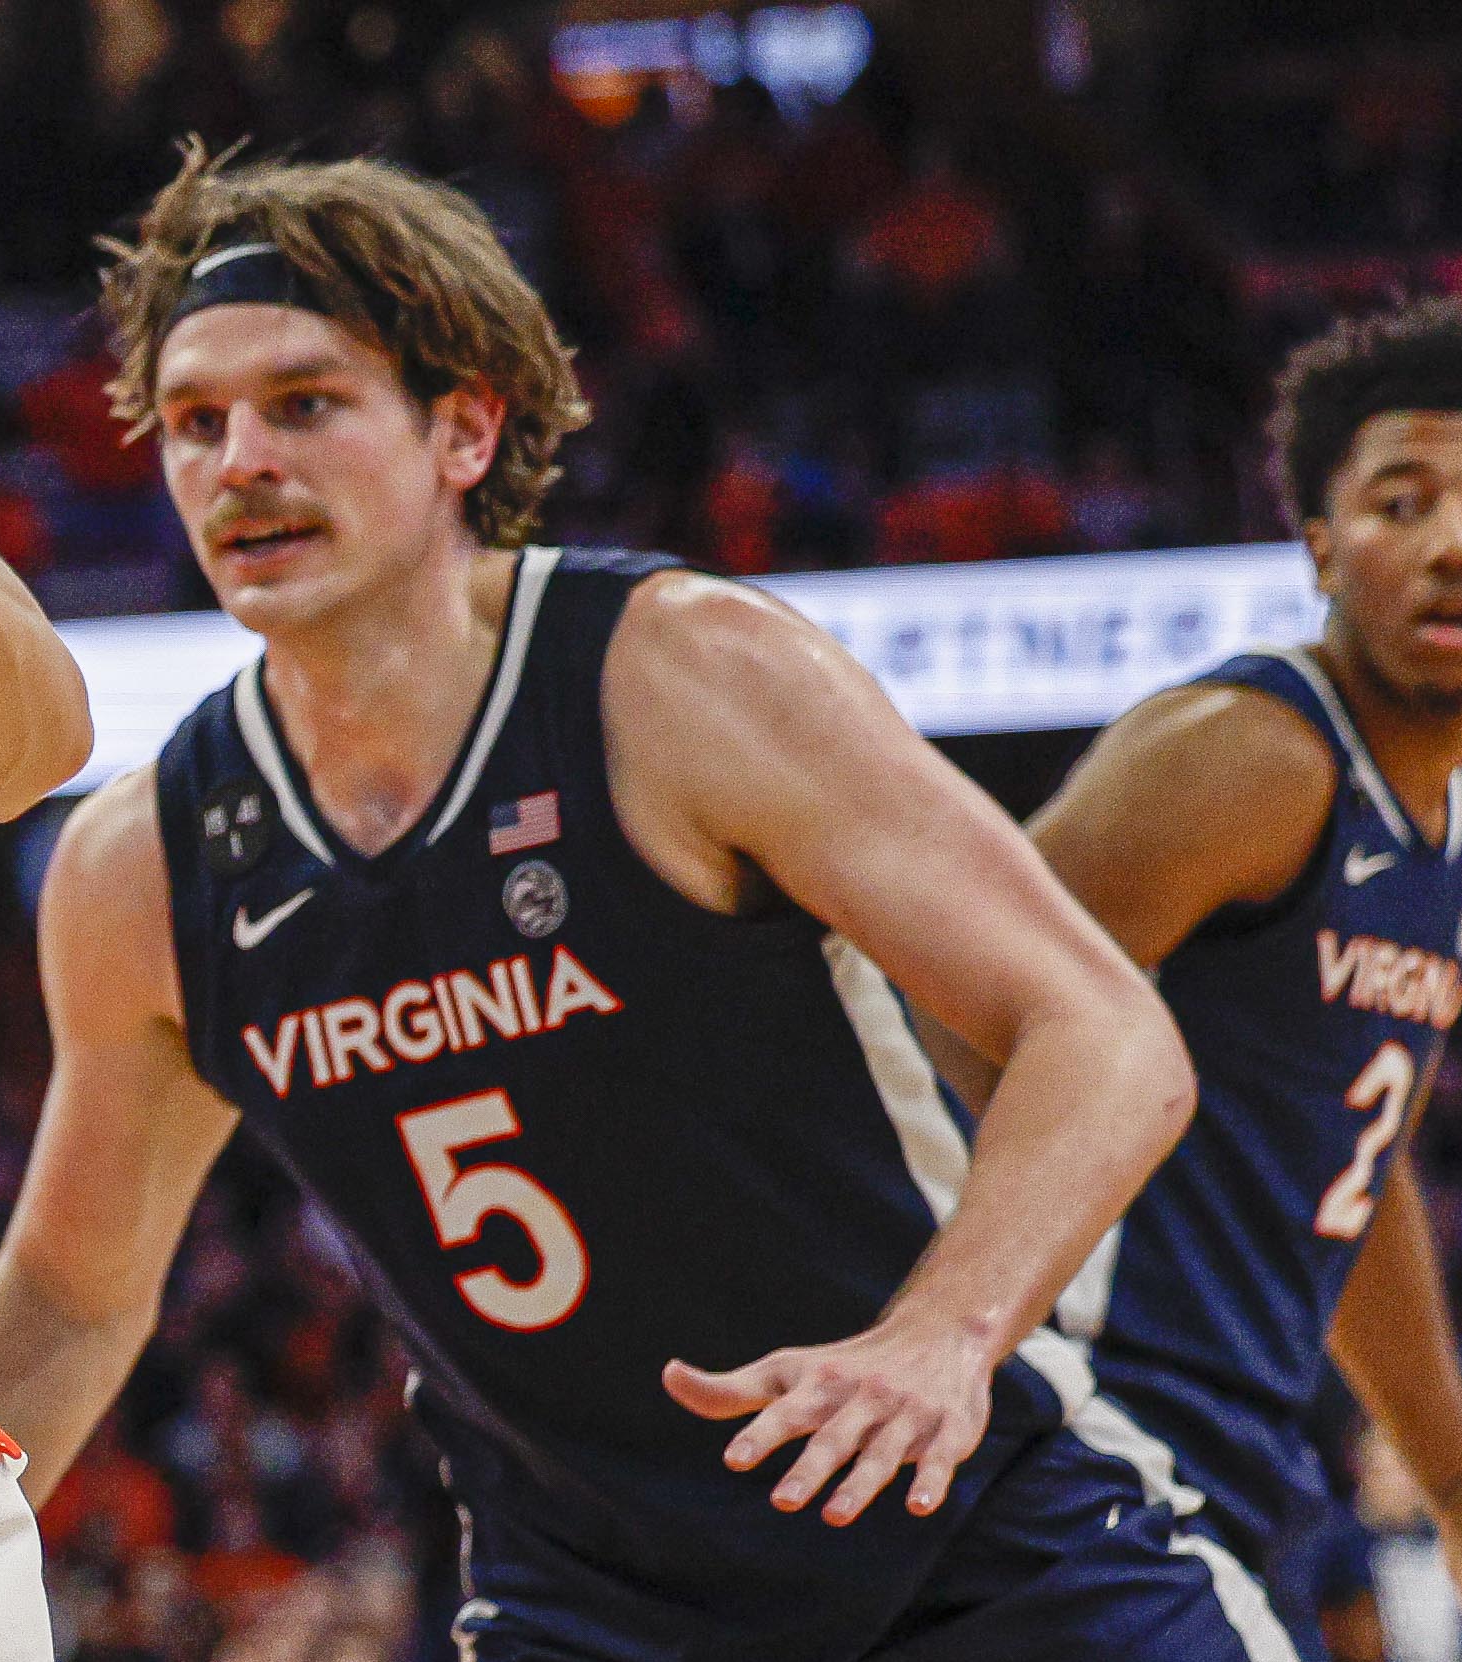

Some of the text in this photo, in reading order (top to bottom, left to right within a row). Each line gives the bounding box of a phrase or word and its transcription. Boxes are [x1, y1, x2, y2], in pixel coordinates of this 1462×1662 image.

[240, 942, 626, 1100] VIRGINIA
[1315, 927, 1462, 1031] VIRGIN
[393, 1086, 592, 1335] 5
[1313, 1038, 1416, 1242] 2
